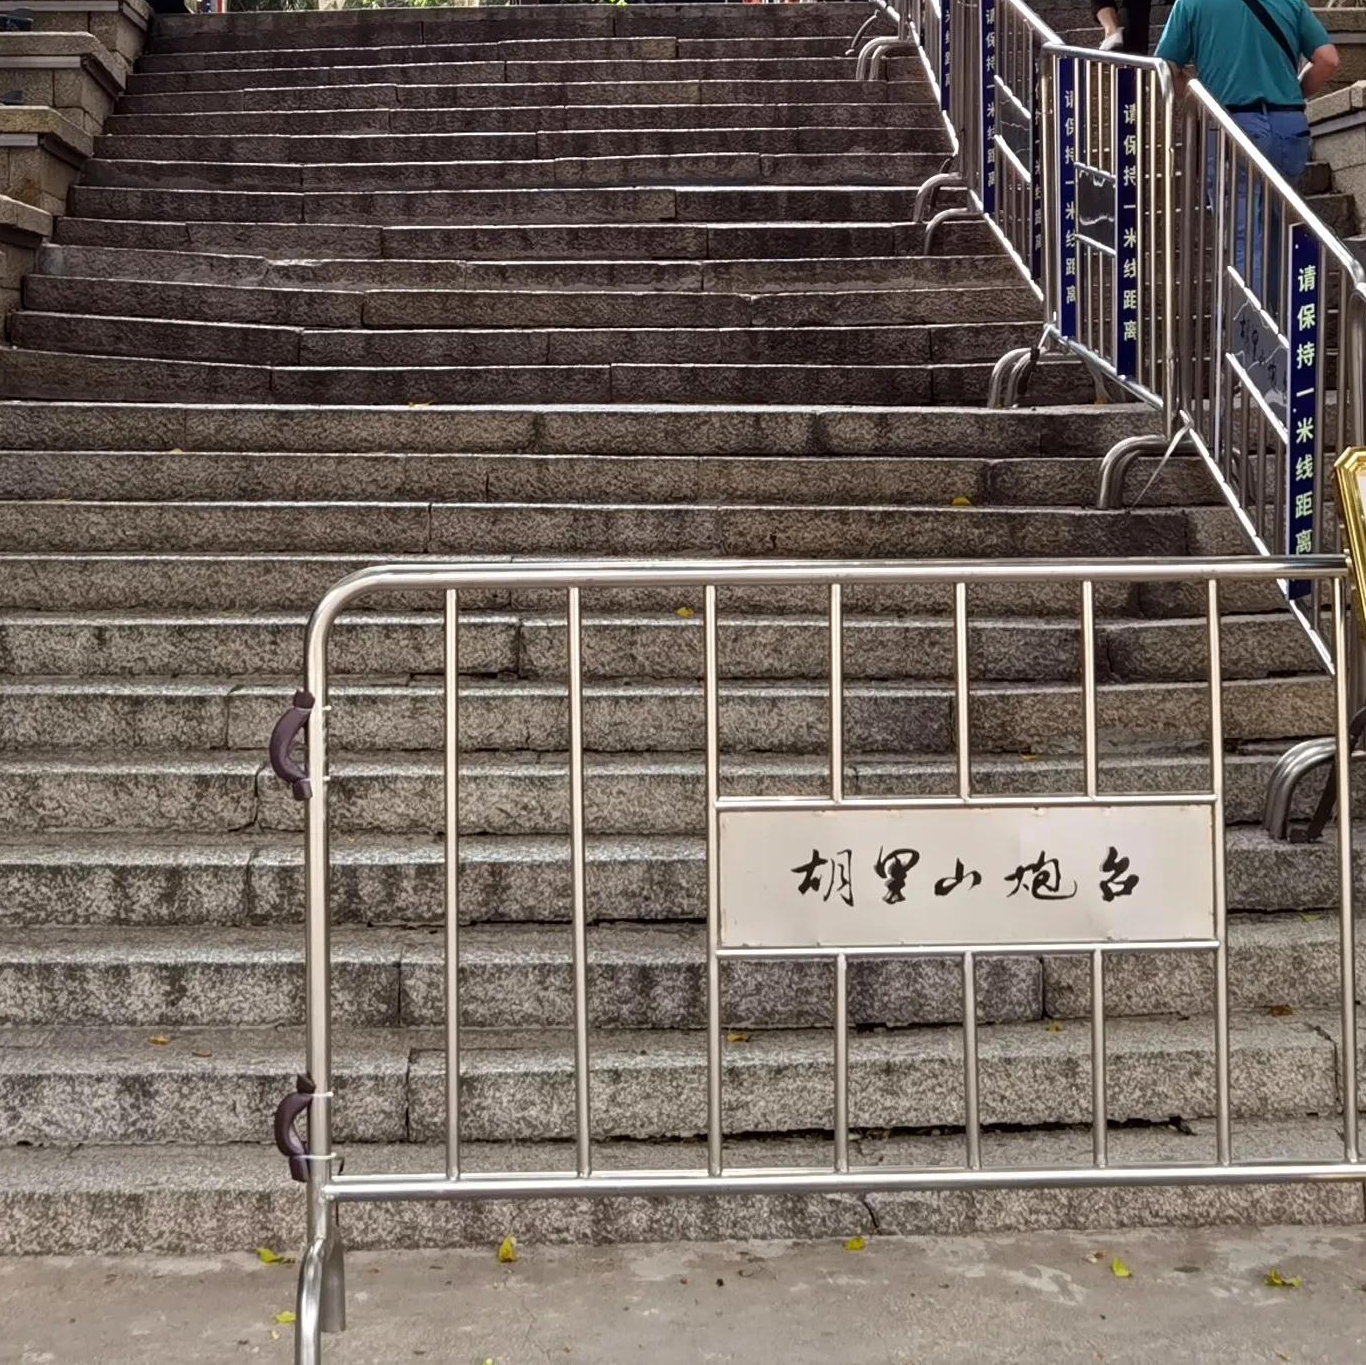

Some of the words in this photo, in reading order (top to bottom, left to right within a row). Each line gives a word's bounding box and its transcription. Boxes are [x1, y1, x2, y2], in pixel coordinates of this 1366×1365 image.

[1123, 103, 1137, 342] 请保持一米线距离
[1294, 264, 1317, 555] 请保持一米线距离
[790, 846, 1140, 908] 胡里山炮台
